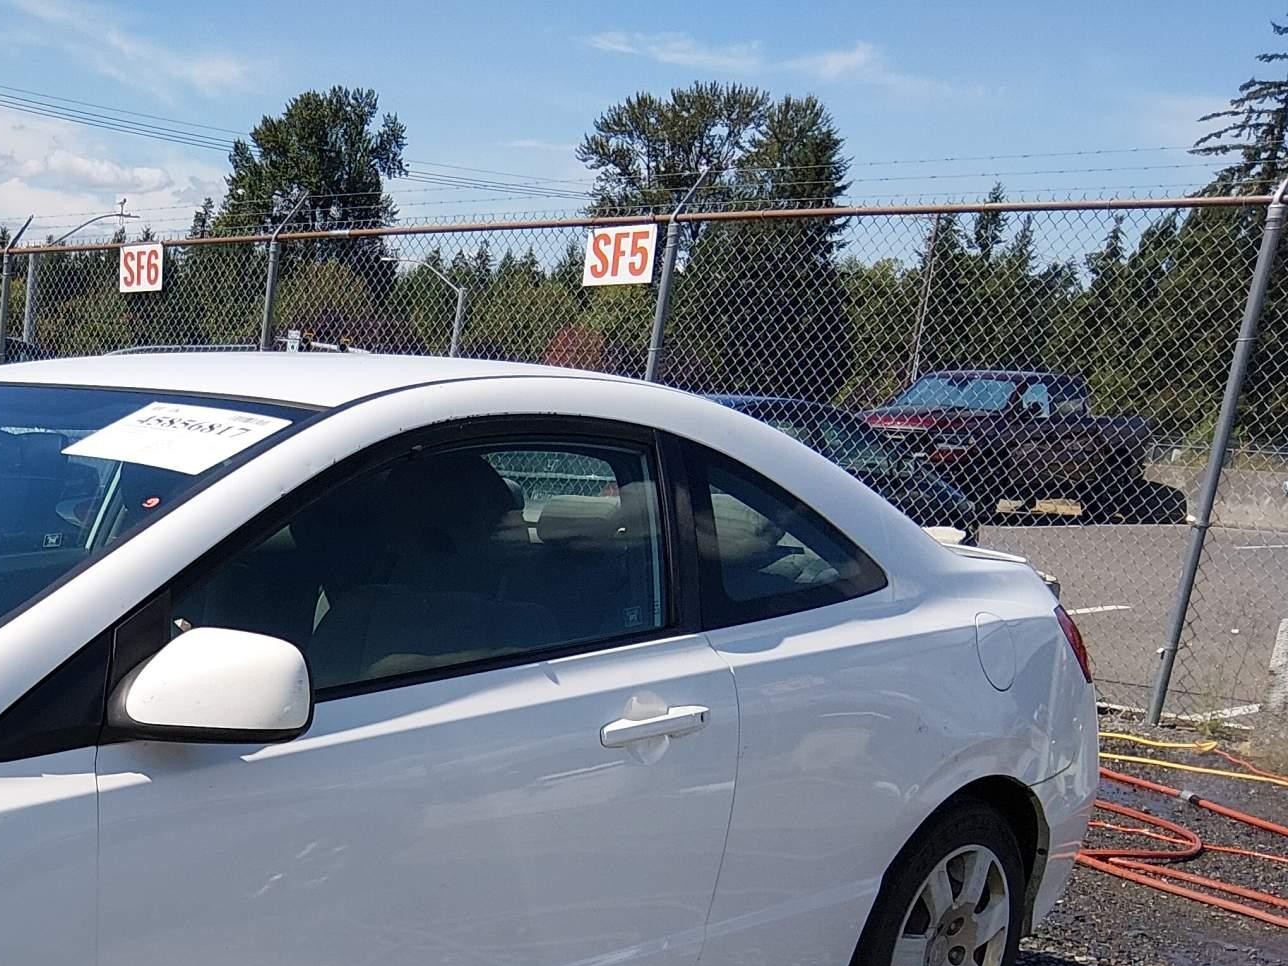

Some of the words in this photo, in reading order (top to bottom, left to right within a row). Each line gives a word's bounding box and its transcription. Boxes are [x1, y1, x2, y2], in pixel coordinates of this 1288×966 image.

[123, 250, 159, 287] SF6
[590, 231, 650, 278] SF5
[136, 414, 252, 439] 45856817
